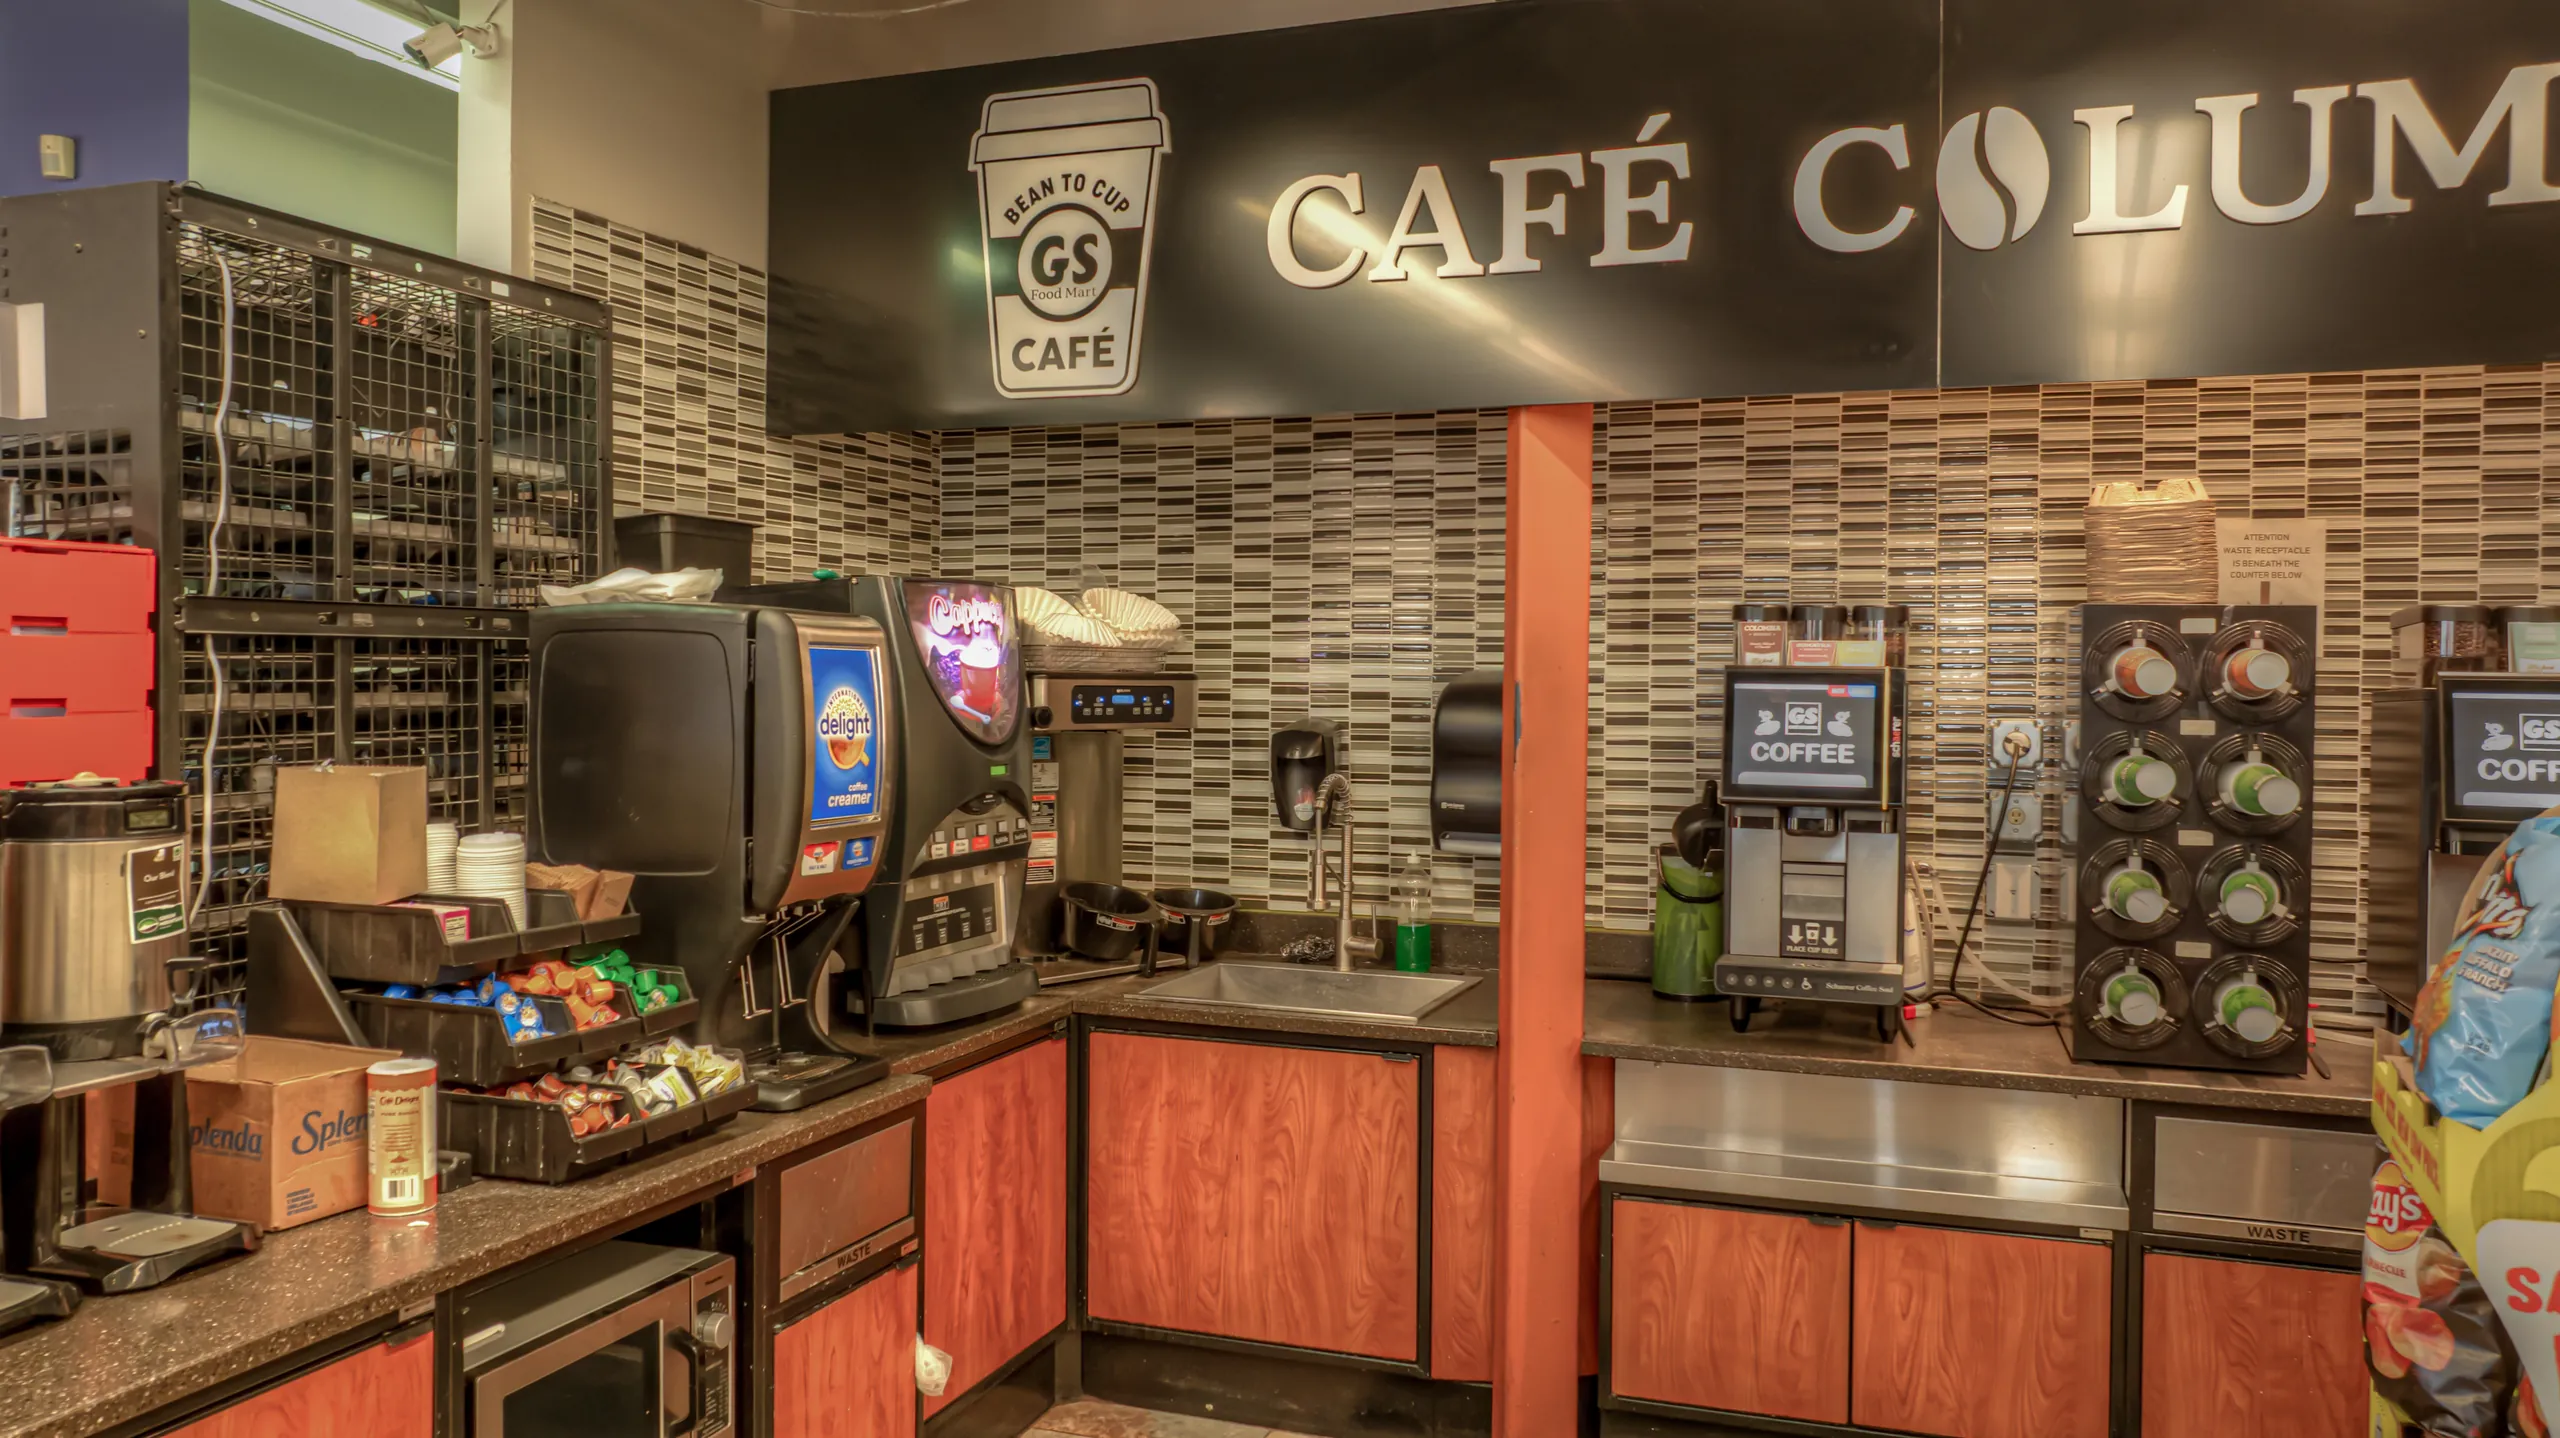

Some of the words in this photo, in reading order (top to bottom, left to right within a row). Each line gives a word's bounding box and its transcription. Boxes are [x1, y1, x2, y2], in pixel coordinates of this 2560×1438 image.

[1003, 177, 1056, 226] BEAN
[1061, 173, 1086, 193] TO
[1092, 179, 1130, 214] CUP
[1267, 112, 1693, 290] CAFÉ
[1031, 233, 1099, 286] GS
[1030, 287, 1063, 301] Food
[1065, 285, 1097, 300] Mart
[1011, 326, 1116, 372] CAFÉ
[2243, 533, 2290, 541] ATTENTION
[2223, 546, 2252, 554] WASTE
[2255, 546, 2311, 555] RECEPTACLE
[2232, 559, 2241, 568] IS
[2242, 559, 2282, 568] BENEATH
[2284, 559, 2301, 568] THE
[2230, 571, 2269, 579] COUNTER
[2271, 571, 2302, 579] BELOW
[827, 689, 866, 711] INTERNATIONAL
[1788, 706, 1819, 725] GS
[819, 711, 871, 741] delight
[1750, 741, 1856, 764] COFFEE
[848, 781, 869, 792] coffee
[827, 792, 873, 808] creamer
[1786, 945, 1806, 953] PLACE
[1821, 947, 1839, 955] HERE
[189, 1117, 263, 1154] plenda
[291, 1109, 368, 1155] Splen
[2247, 1226, 2310, 1243] WASTE
[837, 1242, 872, 1269] WASTE
